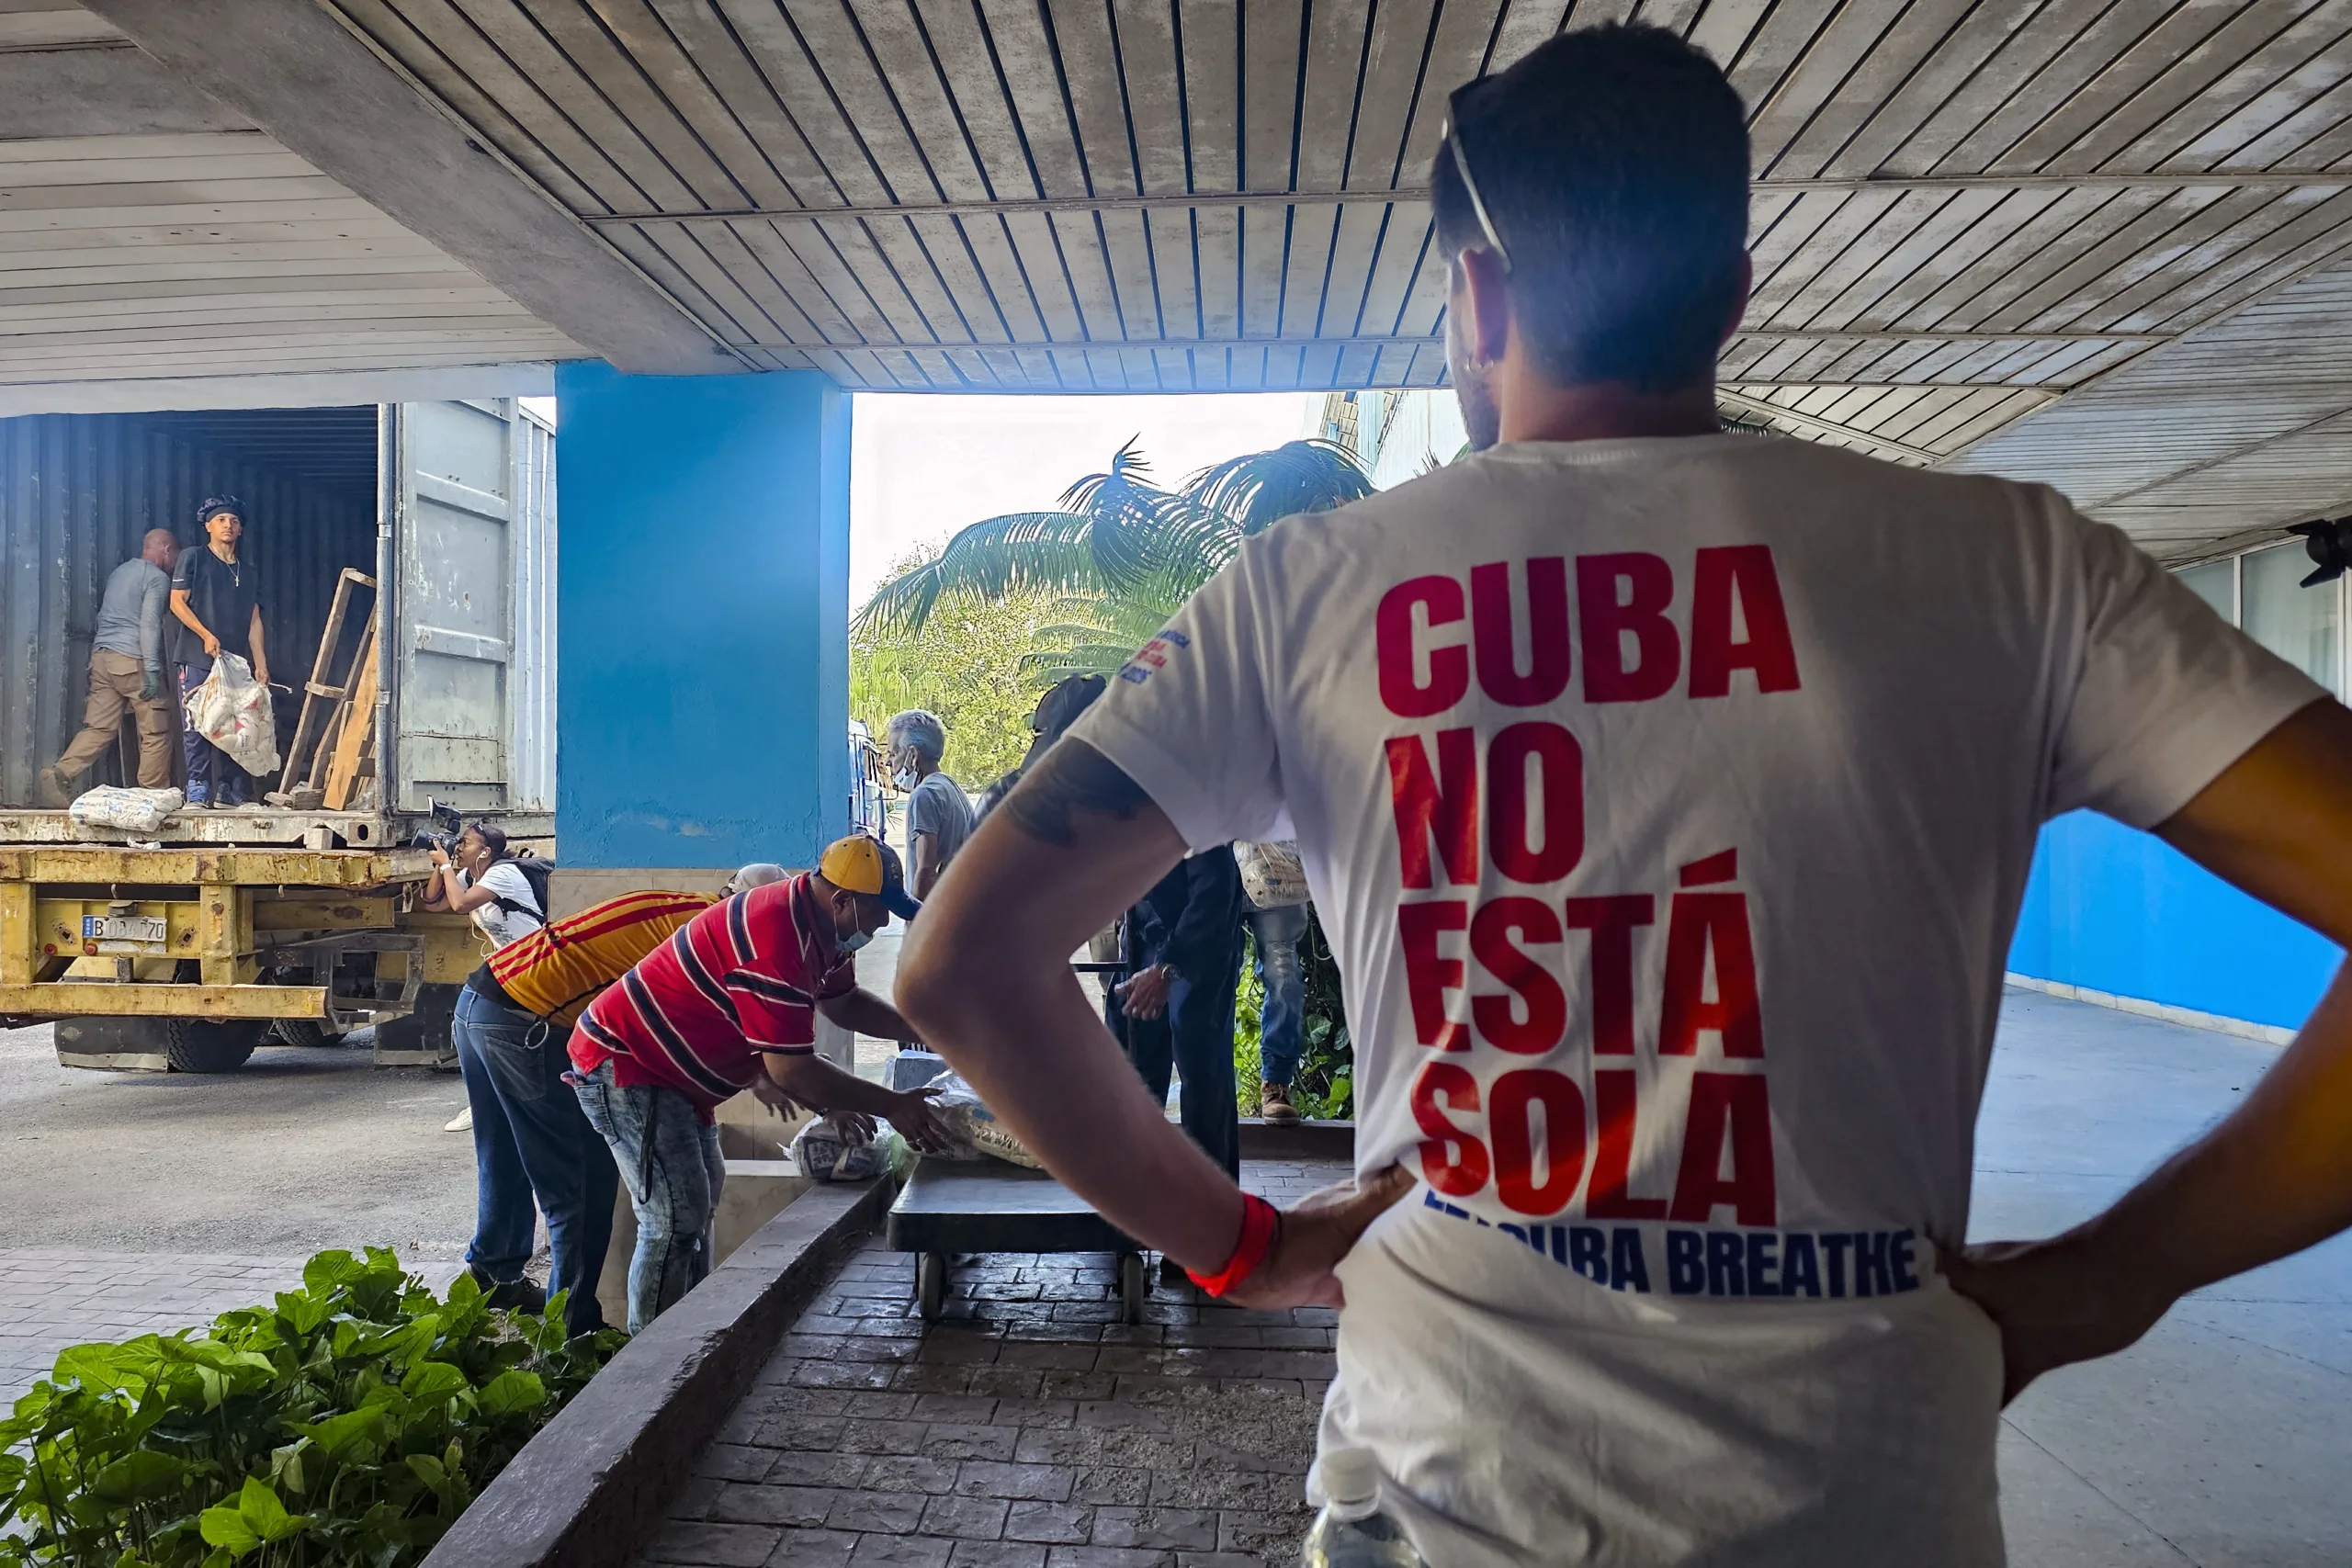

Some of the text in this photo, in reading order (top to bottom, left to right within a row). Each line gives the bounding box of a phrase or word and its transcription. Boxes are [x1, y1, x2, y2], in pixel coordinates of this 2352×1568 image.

[1376, 545, 1801, 718] CUBA
[1385, 721, 1585, 889] NO
[1398, 847, 1765, 1059] ESTÁ
[1411, 1061, 1776, 1227] SOLA
[1668, 1228, 1919, 1298] BREATHE
